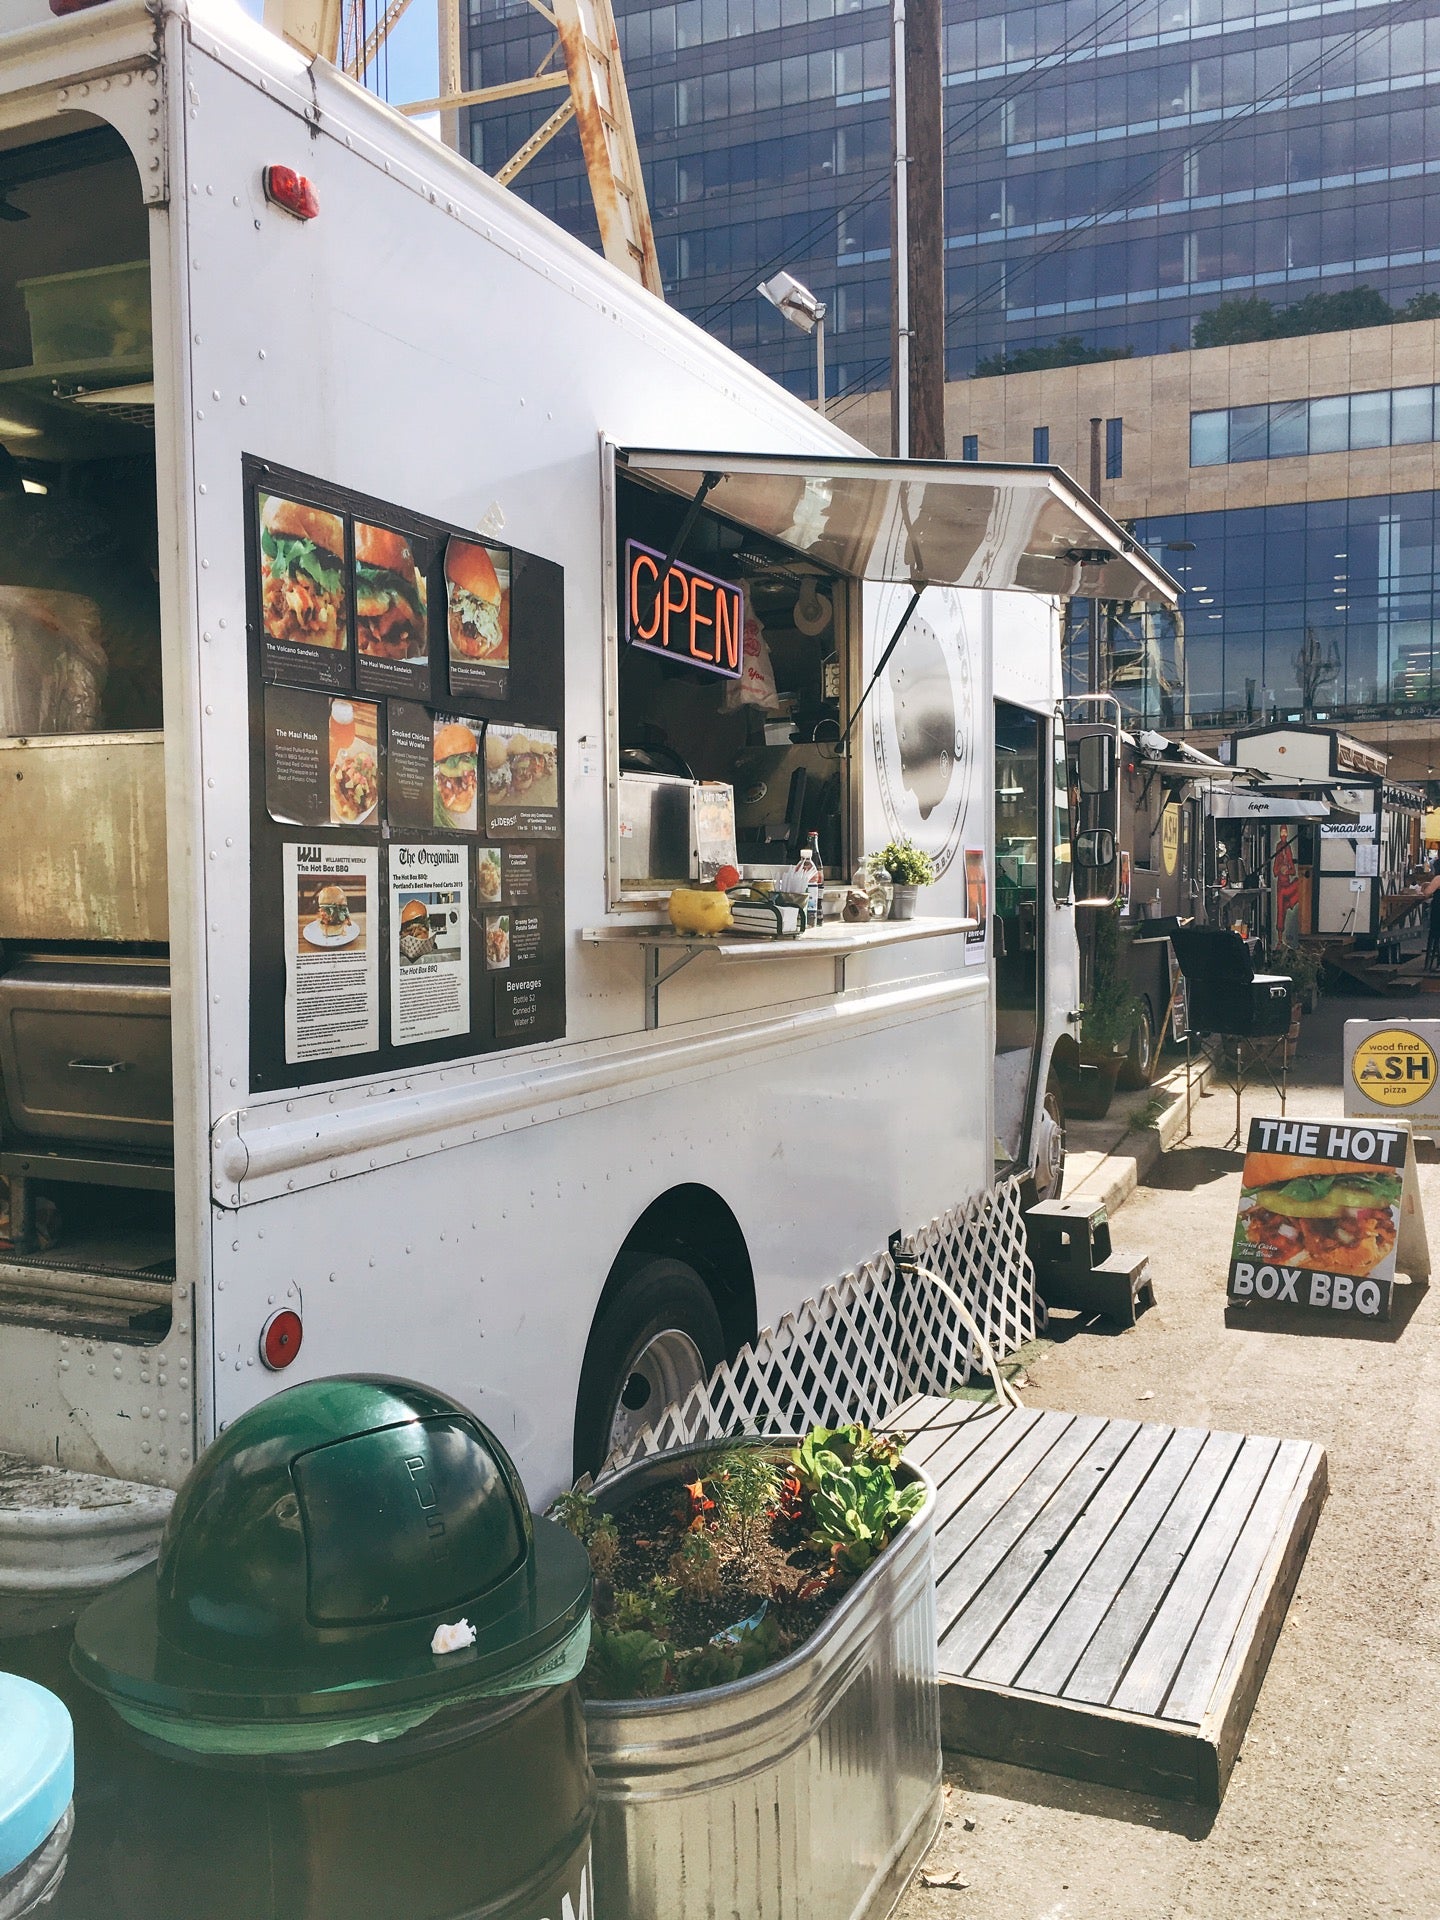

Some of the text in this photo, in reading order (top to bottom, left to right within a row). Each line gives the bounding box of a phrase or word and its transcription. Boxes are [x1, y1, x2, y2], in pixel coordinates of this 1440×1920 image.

[631, 555, 739, 668] OPEN
[266, 643, 319, 658] The Volcano Sandwich
[393, 666, 412, 674] Sandwich
[276, 728, 318, 741] The Maui Mash
[391, 729, 430, 742] Smoked Chicken
[396, 738, 425, 750] Maui Wowie
[399, 848, 460, 867] The Oregonian
[297, 864, 309, 872] The
[310, 864, 322, 872] Hot
[335, 865, 349, 873] BBQ
[400, 964, 438, 976] The Hot Box BBQ
[506, 980, 542, 992] Beverages
[513, 994, 536, 1004] Bottle $2
[512, 1006, 530, 1016] Canned
[513, 1018, 529, 1026] Water
[1369, 1043, 1420, 1051] wood fired
[1360, 1056, 1430, 1081] ASH
[1384, 1086, 1407, 1095] pizza
[1259, 1121, 1398, 1163] THE HOT
[1233, 1263, 1381, 1316] BOX BBQ
